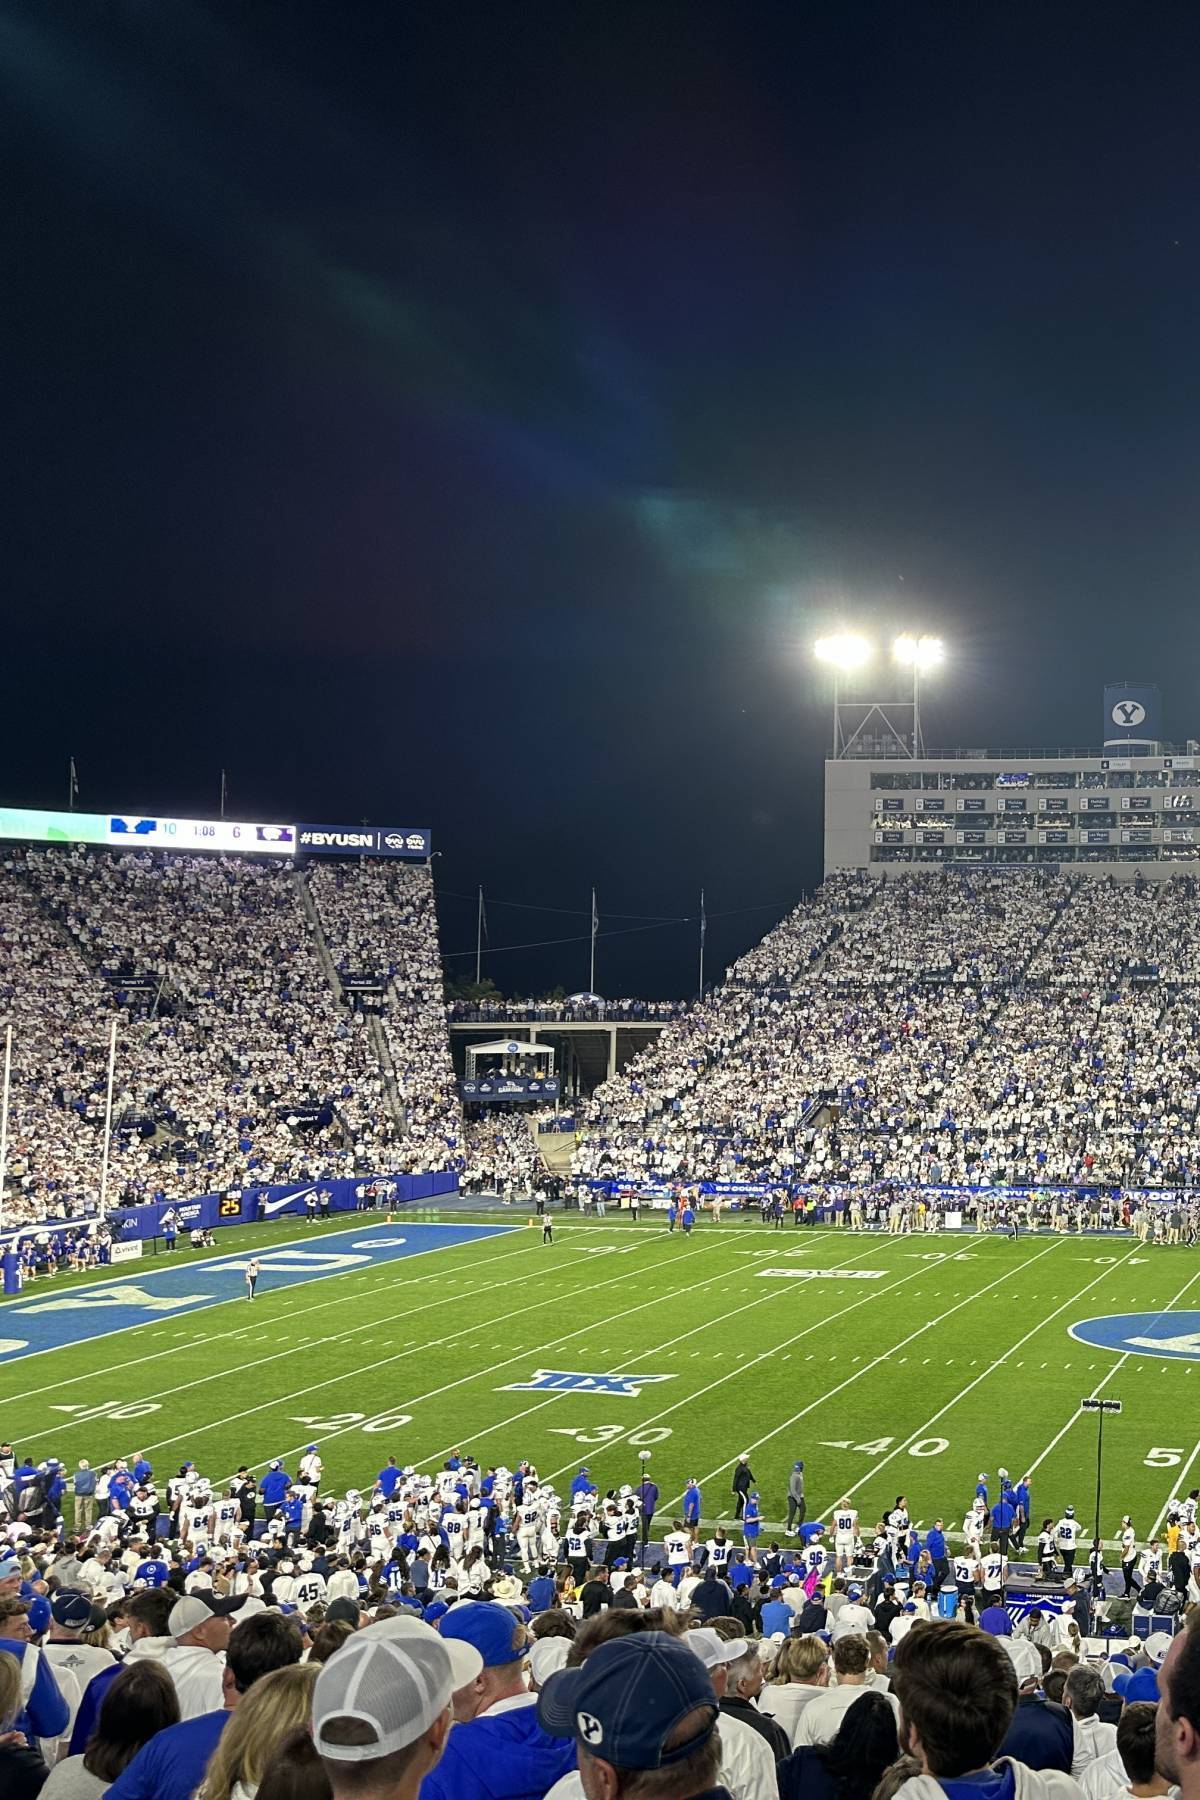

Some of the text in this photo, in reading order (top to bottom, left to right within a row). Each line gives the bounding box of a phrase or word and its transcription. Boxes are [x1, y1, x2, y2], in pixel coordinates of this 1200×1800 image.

[1117, 703, 1140, 724] Y
[163, 823, 177, 835] 10
[194, 825, 216, 837] 1:08
[300, 832, 373, 847] #BYUSN
[180, 1209, 200, 1218] AMERICA
[221, 1200, 239, 1215] 25
[122, 1217, 138, 1229] KIN
[73, 1400, 163, 1420] 10
[305, 1412, 413, 1433] 20
[576, 1424, 672, 1446] 30
[853, 1436, 950, 1458] 40
[221, 1507, 235, 1520] 63
[525, 1510, 538, 1524] 92
[838, 1517, 852, 1530] 80
[1059, 1526, 1073, 1540] 22
[713, 1549, 726, 1561] 91
[809, 1550, 823, 1566] 96
[956, 1565, 969, 1580] 73
[988, 1564, 1001, 1578] 77
[298, 1582, 320, 1602] 45
